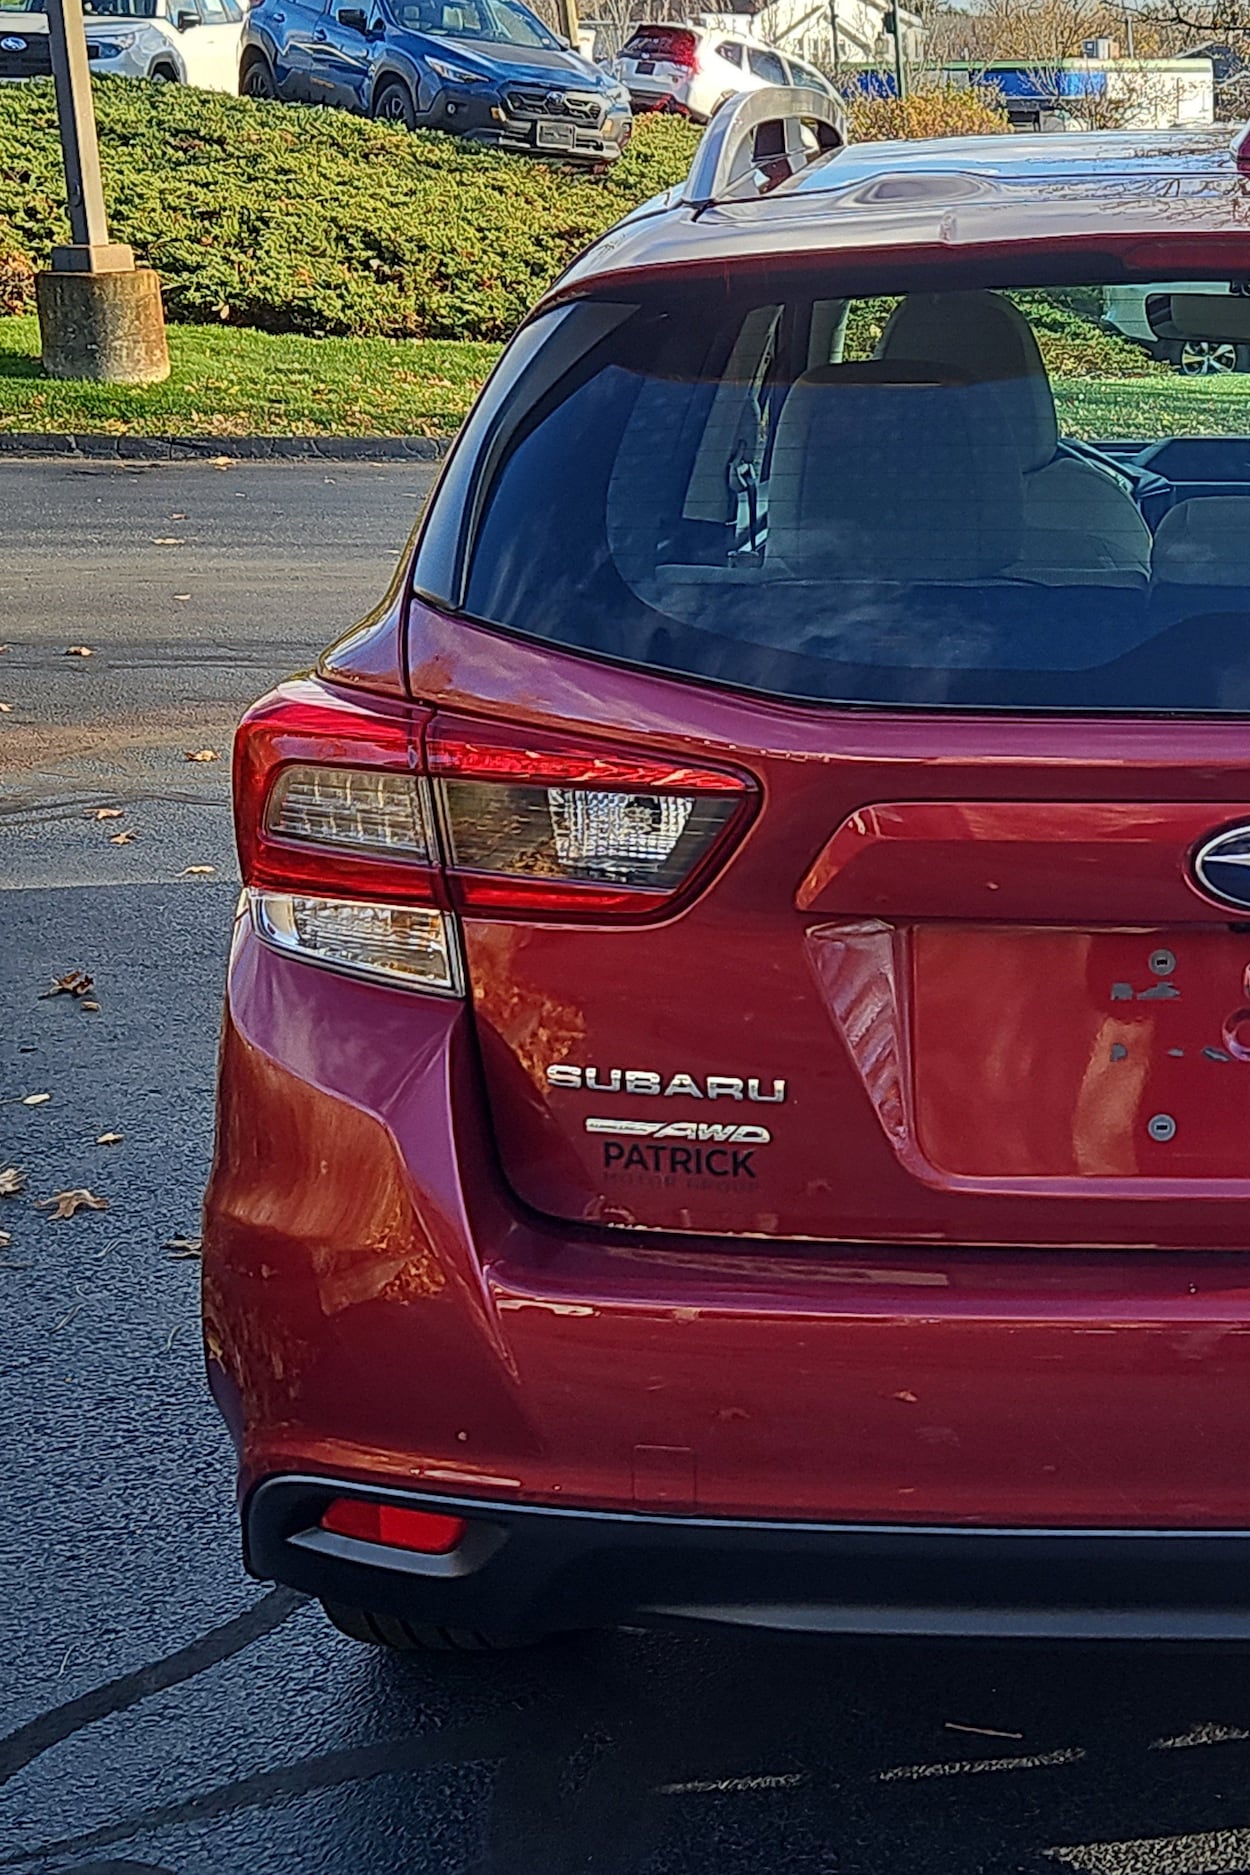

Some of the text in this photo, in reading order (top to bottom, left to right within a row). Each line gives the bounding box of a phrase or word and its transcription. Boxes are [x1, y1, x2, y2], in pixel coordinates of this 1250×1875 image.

[546, 1064, 786, 1103] SUBARU
[652, 1121, 771, 1144] AWD
[603, 1141, 756, 1179] PATRICK
